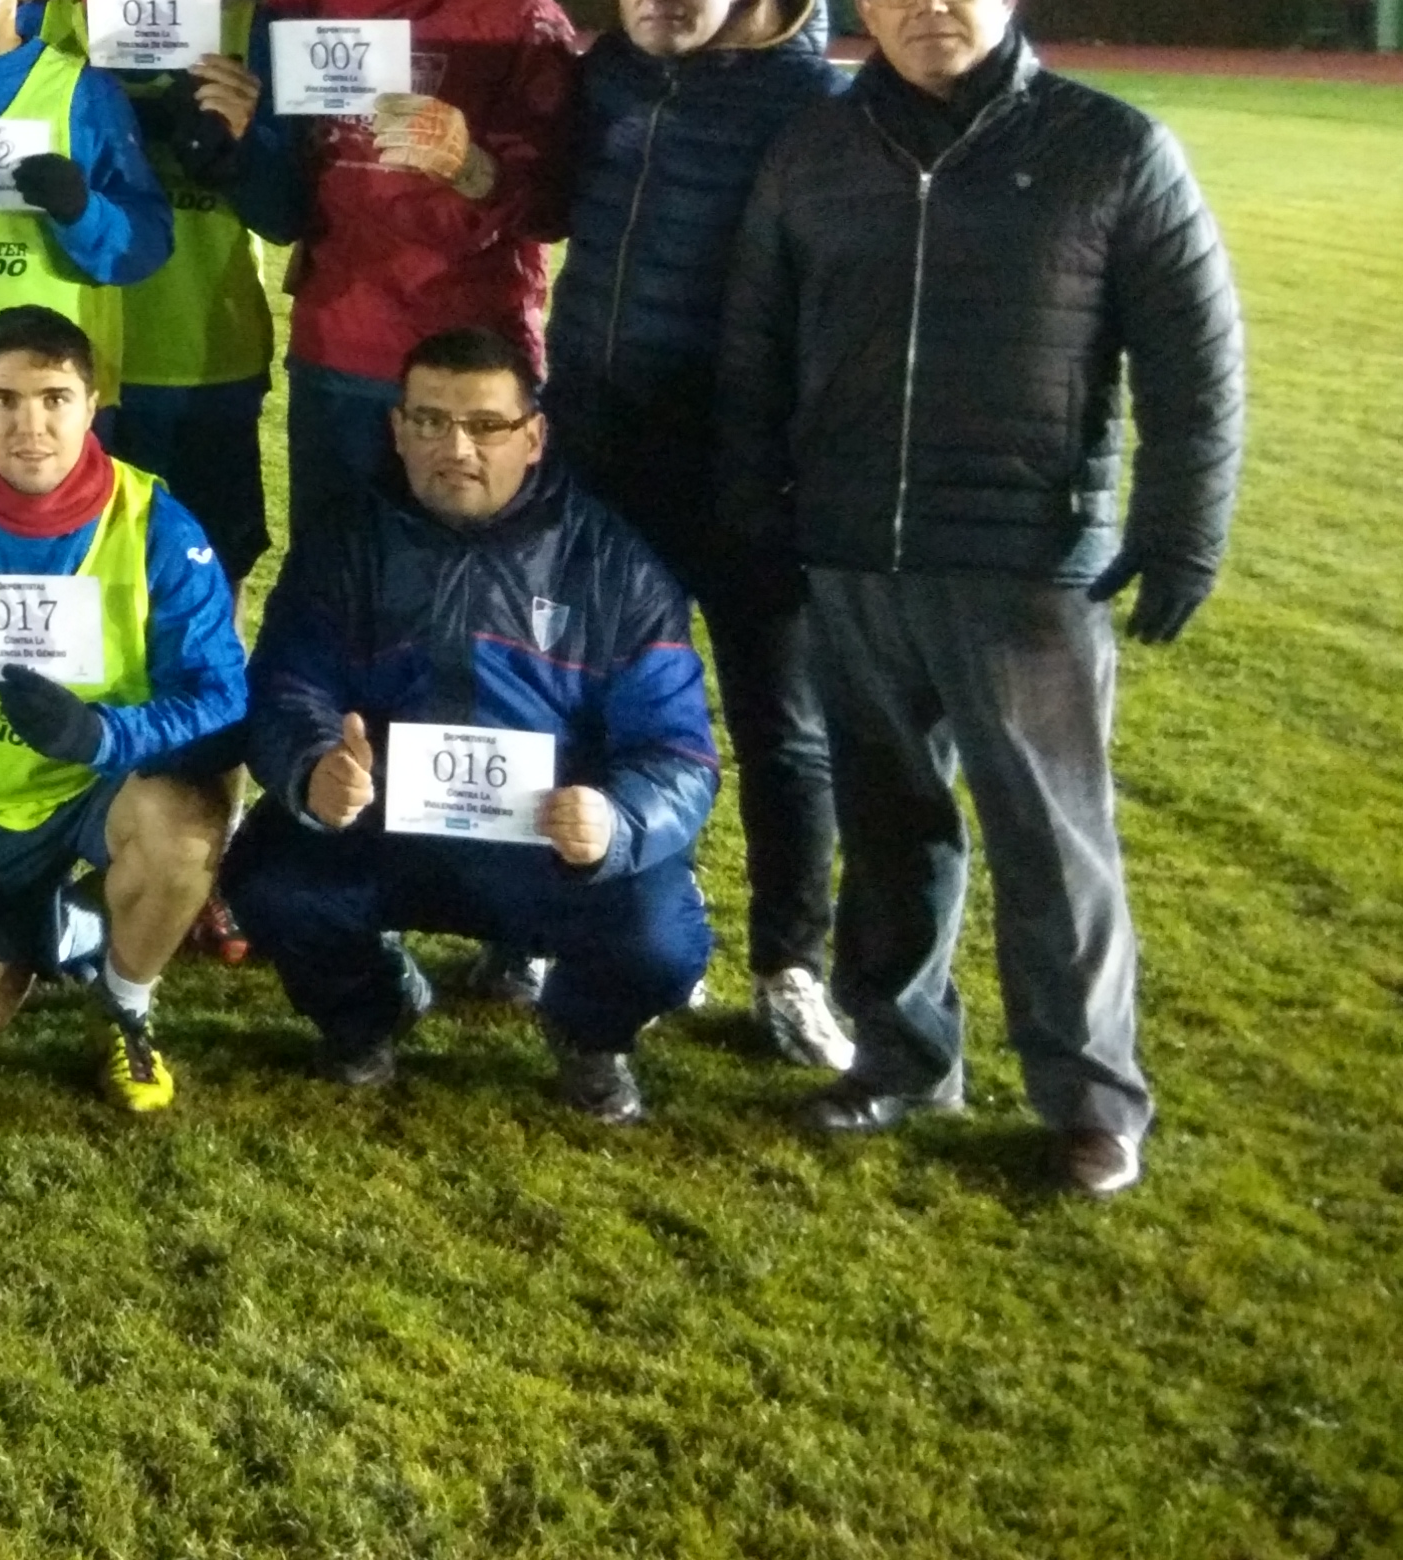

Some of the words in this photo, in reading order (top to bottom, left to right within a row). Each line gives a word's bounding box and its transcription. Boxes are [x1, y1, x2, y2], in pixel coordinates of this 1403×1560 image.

[123, 0, 182, 26] 011
[309, 41, 371, 70] 007
[35, 636, 45, 645] LA
[444, 732, 497, 745] DEPORTISTAS
[433, 750, 507, 788] 016
[447, 788, 478, 800] CONTRA
[480, 791, 491, 801] LA
[424, 800, 465, 811] VIOLENCIA
[467, 802, 478, 813] DE
